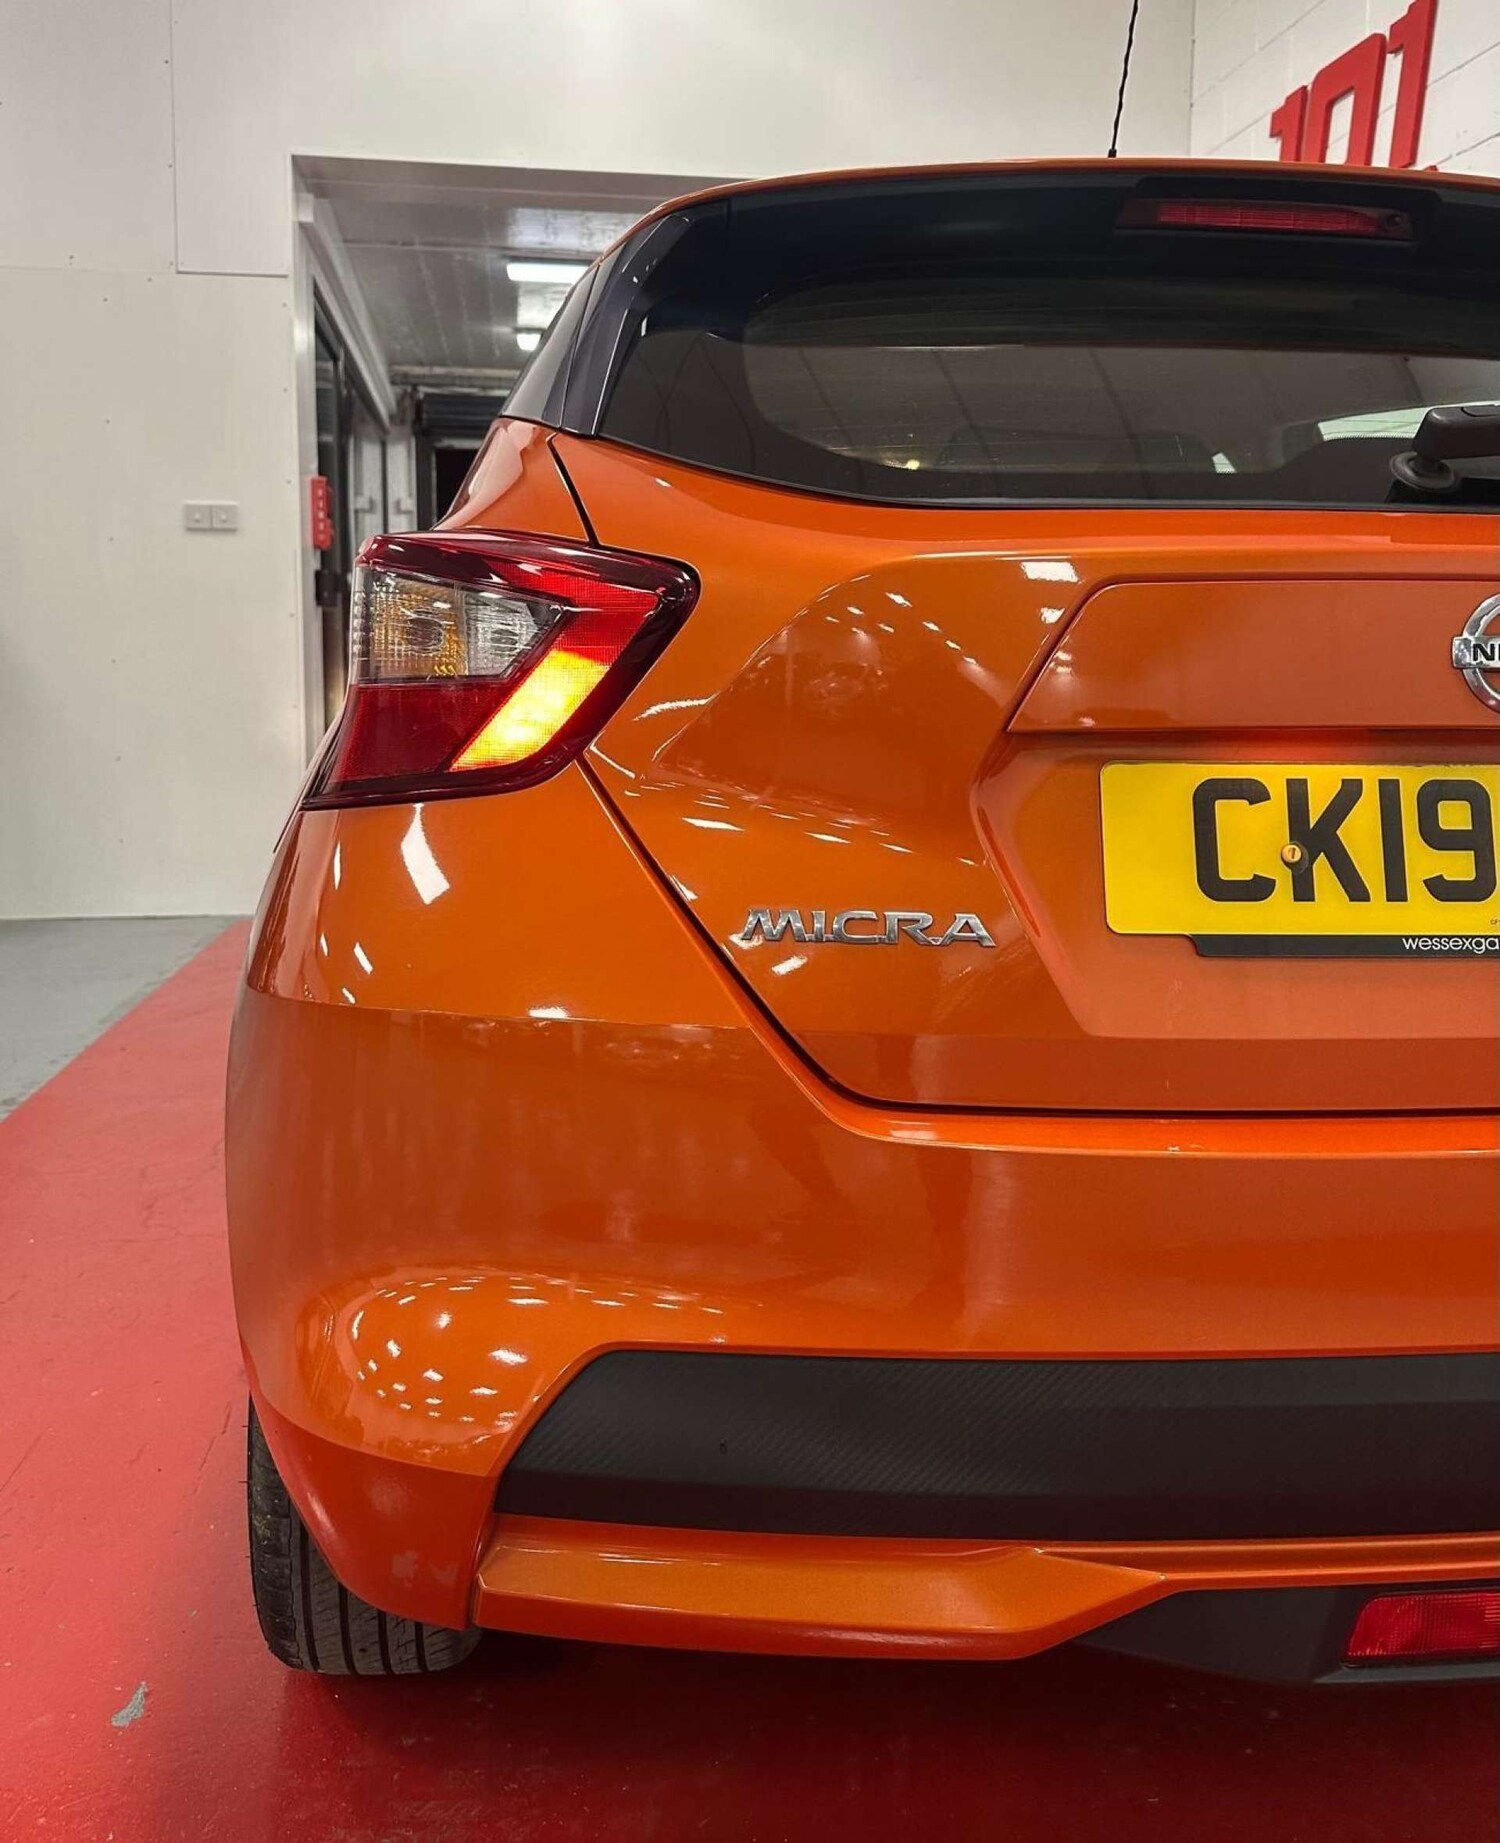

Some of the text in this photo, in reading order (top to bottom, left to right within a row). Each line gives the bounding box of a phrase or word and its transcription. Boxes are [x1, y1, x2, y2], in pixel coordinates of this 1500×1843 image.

[1192, 778, 1497, 903] CK19
[741, 908, 996, 947] MICRA
[1402, 937, 1500, 954] wessexga
